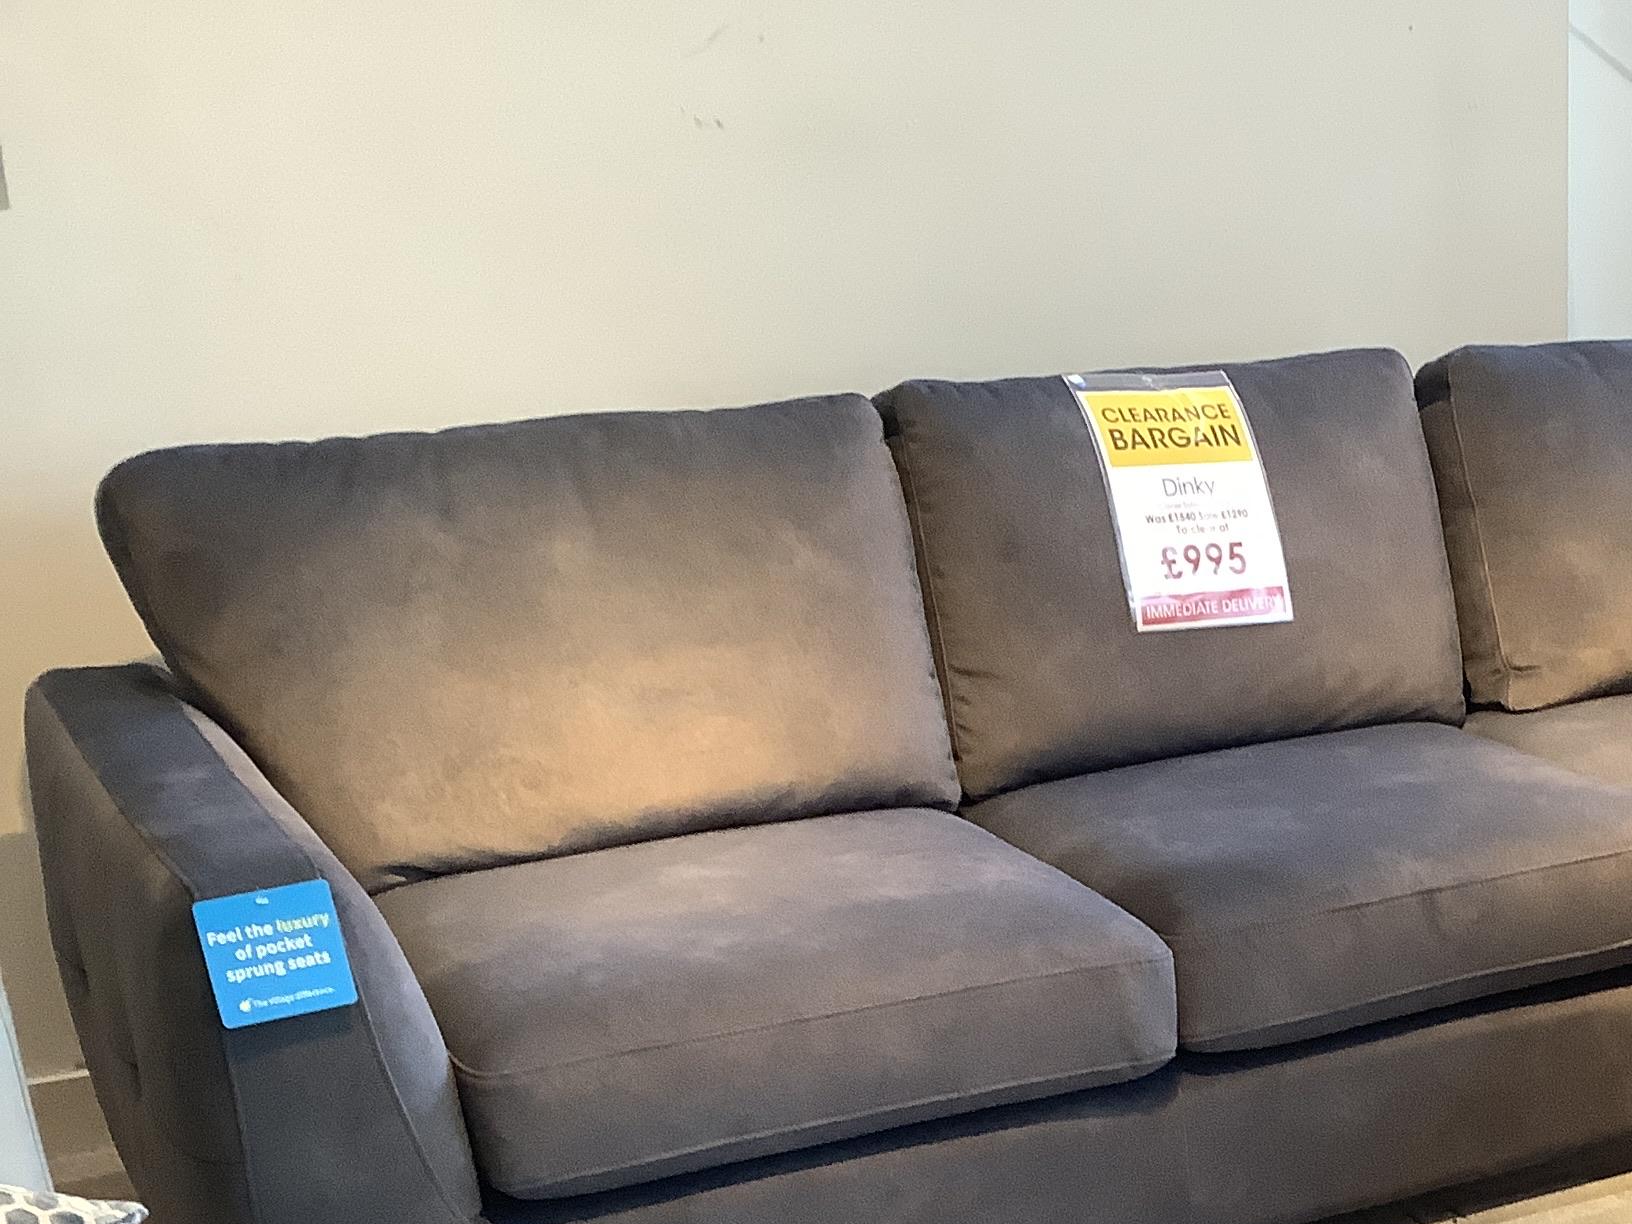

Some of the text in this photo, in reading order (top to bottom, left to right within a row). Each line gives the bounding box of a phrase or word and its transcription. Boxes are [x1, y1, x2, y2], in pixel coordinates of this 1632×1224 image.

[1101, 403, 1231, 423] CLEARANCE
[1108, 424, 1242, 451] BARGAIN
[1162, 476, 1215, 497] Dinky
[1145, 514, 1166, 524] Was
[1219, 522, 1230, 533] at
[1160, 541, 1247, 580] £995
[1146, 594, 1282, 619] IMMEDIATE DELIVERY
[207, 912, 330, 947] Feel the luxury
[234, 933, 313, 962] of pocket
[226, 951, 332, 984] sprung seats
